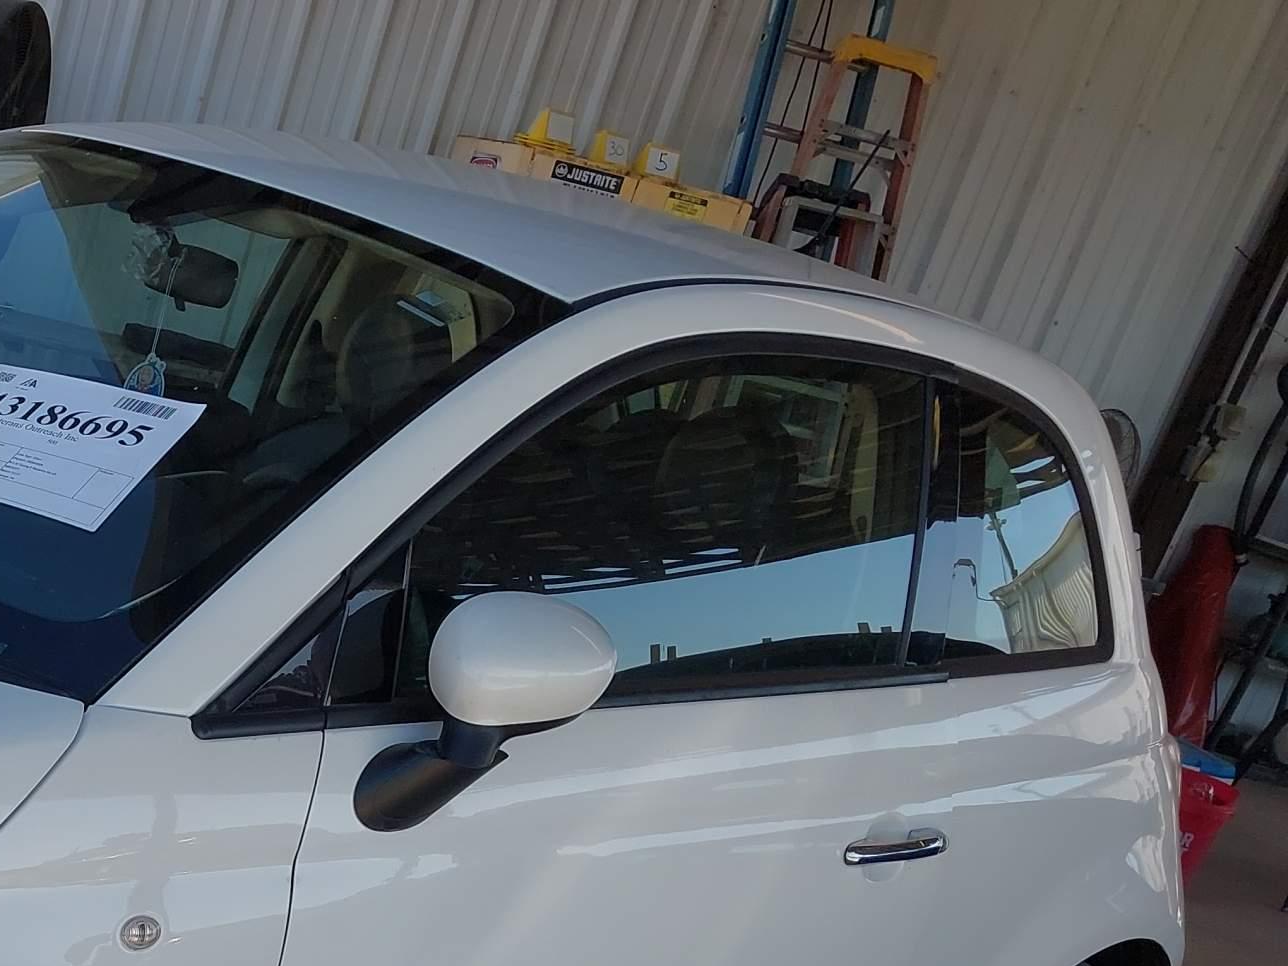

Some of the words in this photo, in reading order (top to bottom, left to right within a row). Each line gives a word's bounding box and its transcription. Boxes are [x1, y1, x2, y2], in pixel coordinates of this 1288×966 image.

[655, 152, 668, 172] 5
[567, 168, 617, 190] JUSTRITE
[24, 423, 64, 438] Outreach
